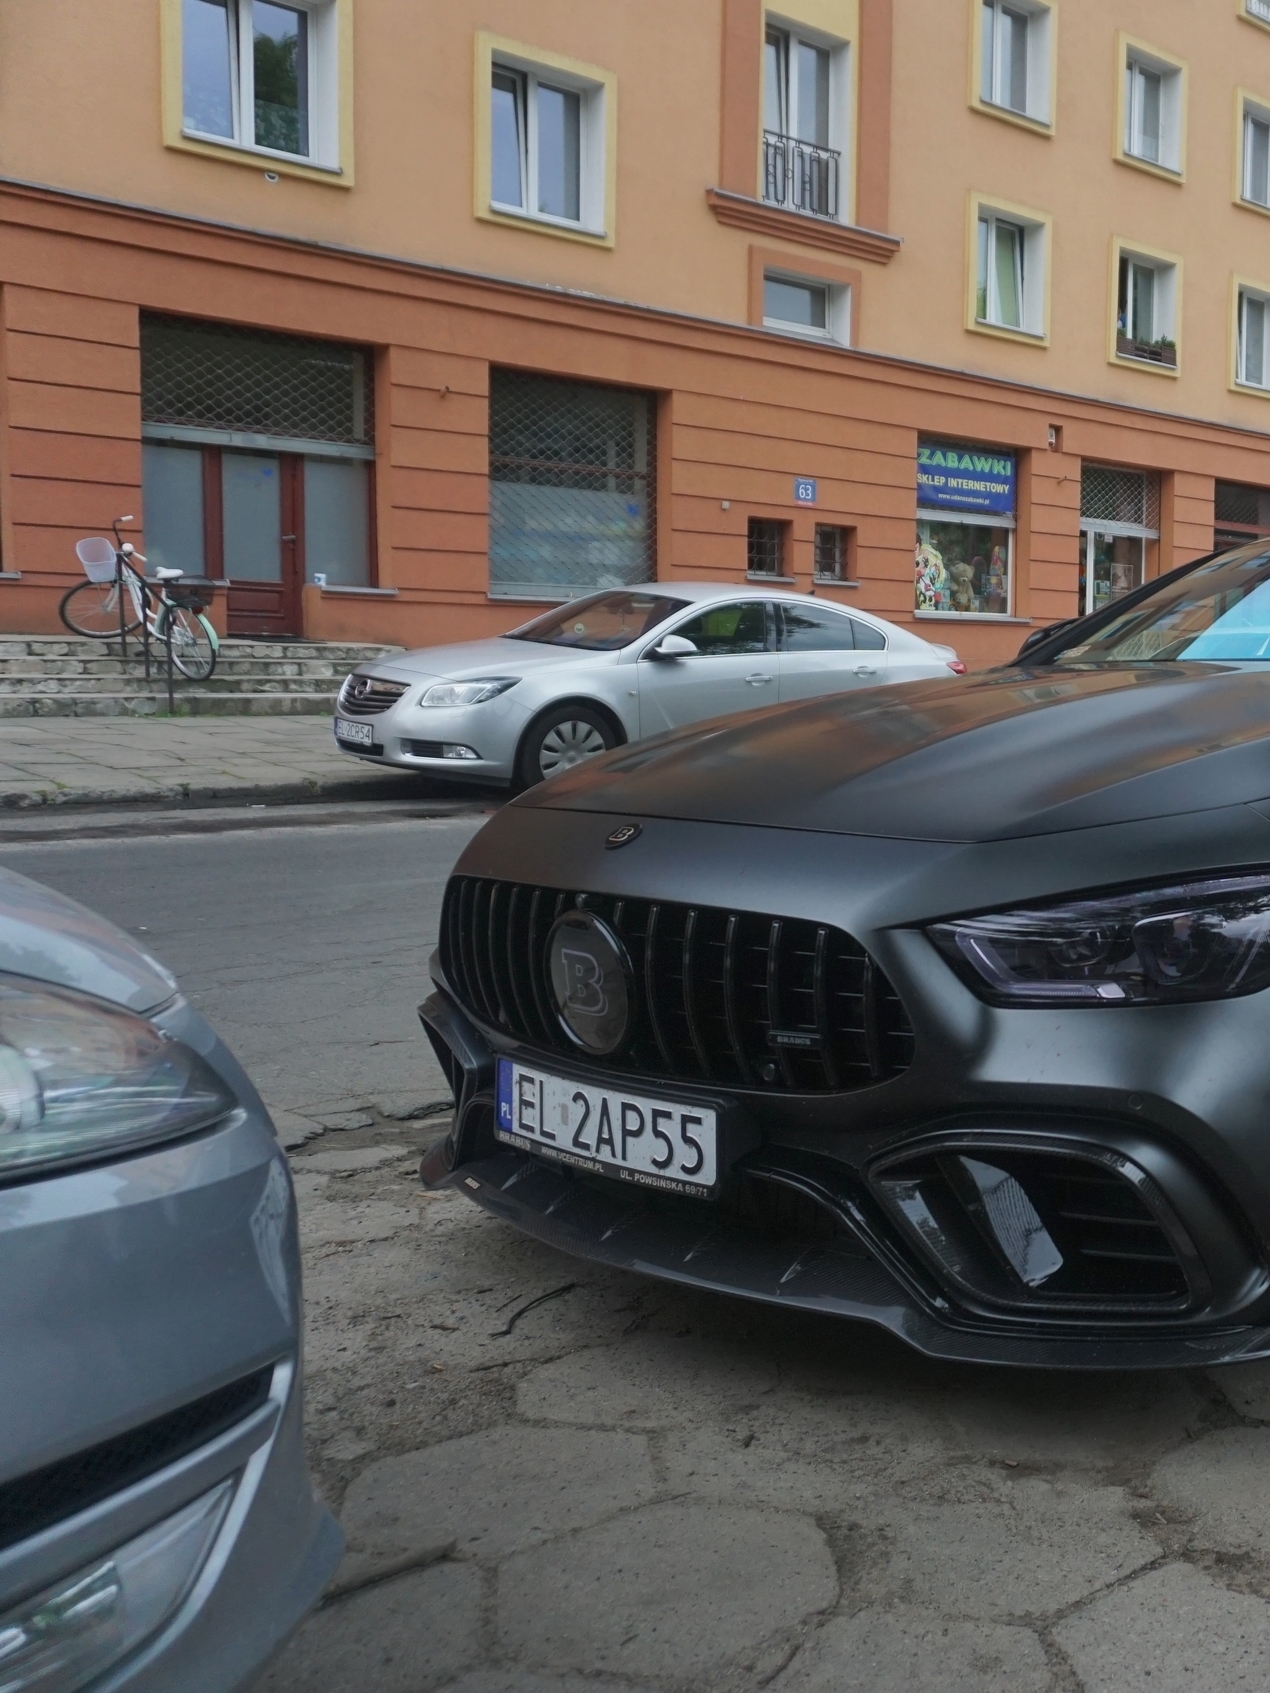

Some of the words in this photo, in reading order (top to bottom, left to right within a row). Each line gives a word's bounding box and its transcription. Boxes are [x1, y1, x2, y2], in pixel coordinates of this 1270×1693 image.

[917, 448, 1011, 476] ZABAWKI
[798, 484, 812, 499] 63
[917, 473, 945, 486] SKLEP
[948, 477, 1009, 494] INTERNETOWY
[561, 948, 608, 1016] B
[501, 1102, 512, 1120] PL
[518, 1072, 556, 1142] EL
[572, 1090, 704, 1176] 2AP55
[541, 1145, 604, 1173] WWW.VCENTRUM.PL
[620, 1169, 632, 1180] UL.
[634, 1173, 683, 1192] POWSIŃSKA
[685, 1184, 708, 1197] 69/71
